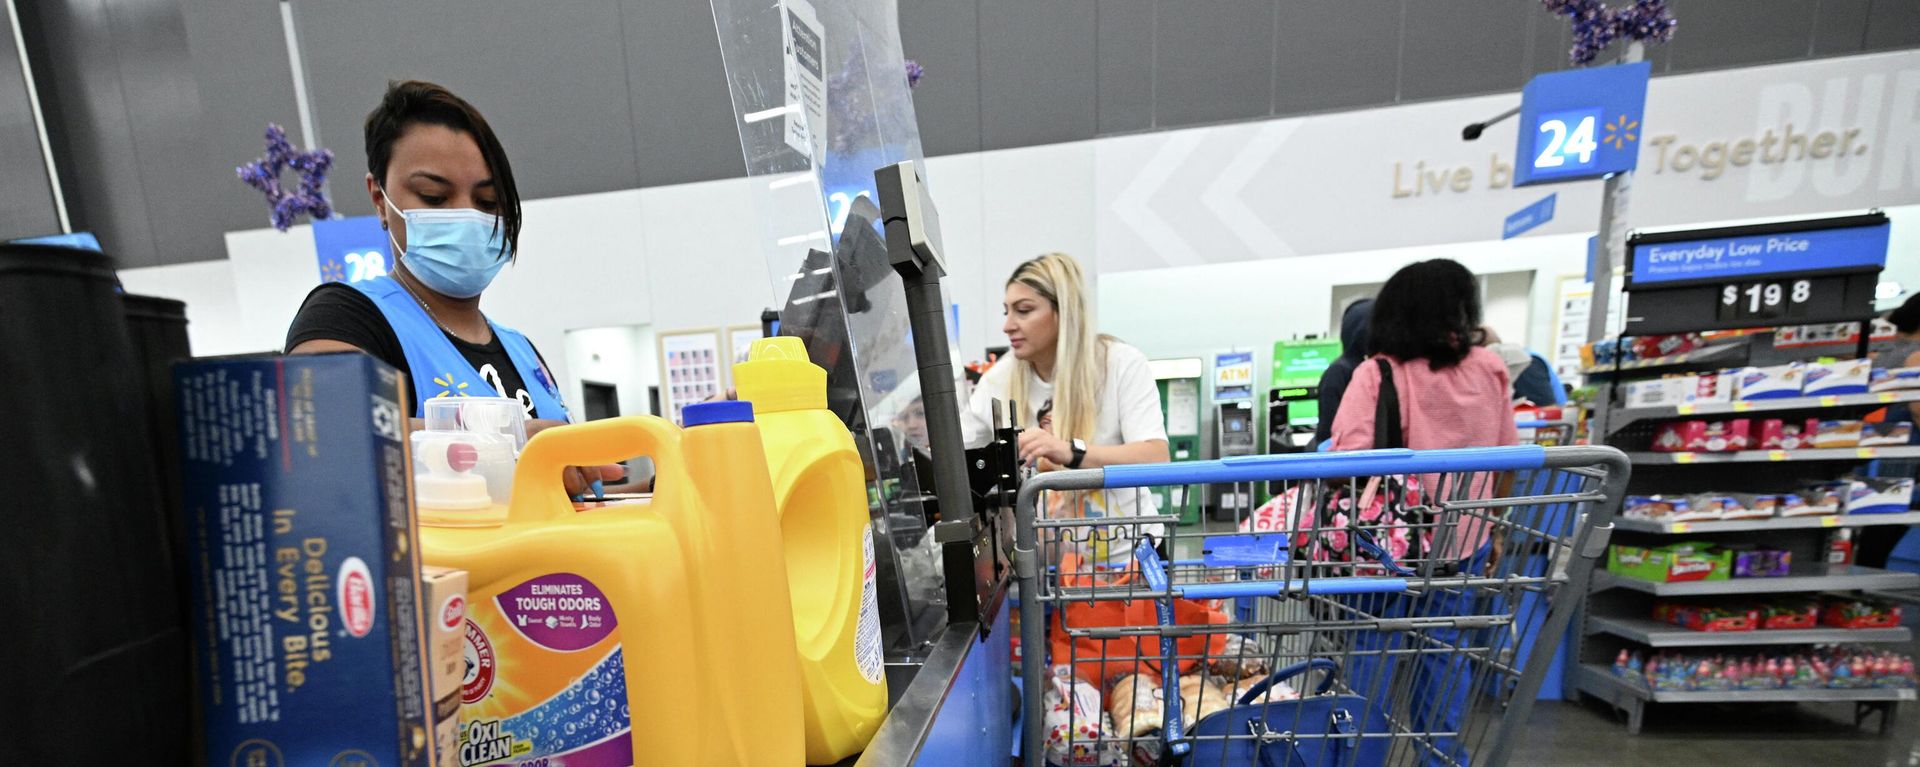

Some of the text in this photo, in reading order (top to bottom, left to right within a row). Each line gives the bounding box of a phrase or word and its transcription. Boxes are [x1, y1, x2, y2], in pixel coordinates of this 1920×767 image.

[1533, 115, 1598, 168] 24
[1648, 123, 1868, 181] Together.
[1392, 160, 1474, 198] Live
[829, 189, 871, 234] 2
[344, 250, 387, 283] 28
[1649, 238, 1809, 263] Everyday Low Price
[1220, 367, 1249, 381] ATM
[273, 509, 310, 693] In Every Bite.
[303, 537, 333, 662] Delicious
[515, 597, 602, 611] TOUGH ODORS
[530, 584, 583, 595] ELIMINATES
[468, 720, 499, 745] OXI
[459, 736, 512, 767] CLEAN
